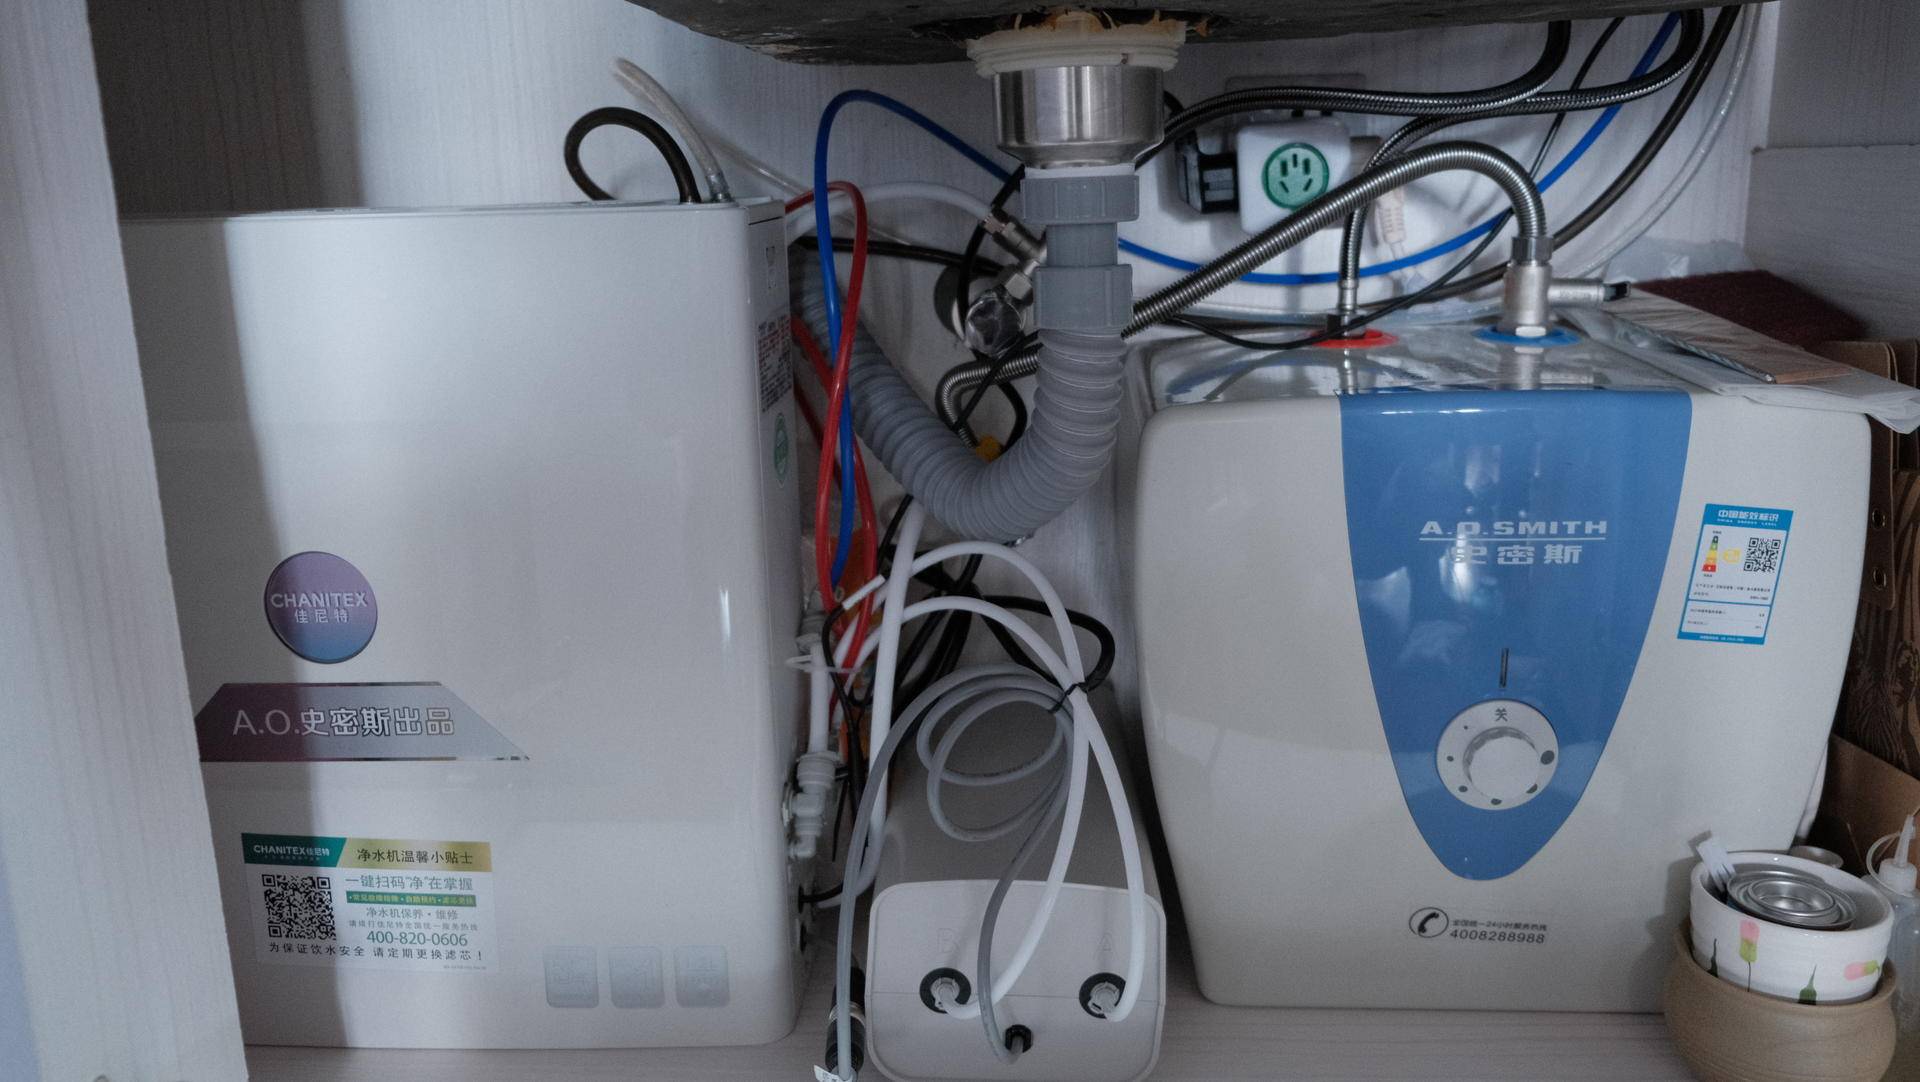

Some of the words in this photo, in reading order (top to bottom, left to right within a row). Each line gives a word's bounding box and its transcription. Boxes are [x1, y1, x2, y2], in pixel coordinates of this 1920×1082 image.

[1420, 520, 1608, 535] A.O.SMITH
[1451, 543, 1583, 565] 史密斯
[270, 592, 368, 608] CHANITEX
[294, 608, 349, 624] 佳尼特
[233, 706, 456, 738] A.O.史密斯出品
[1494, 707, 1509, 722] 关
[356, 848, 474, 865] 净水机温馨小贴士
[366, 930, 469, 947] 400-820-0606
[1450, 929, 1546, 944] 4008288988
[269, 942, 365, 957] 为保证饮水安全
